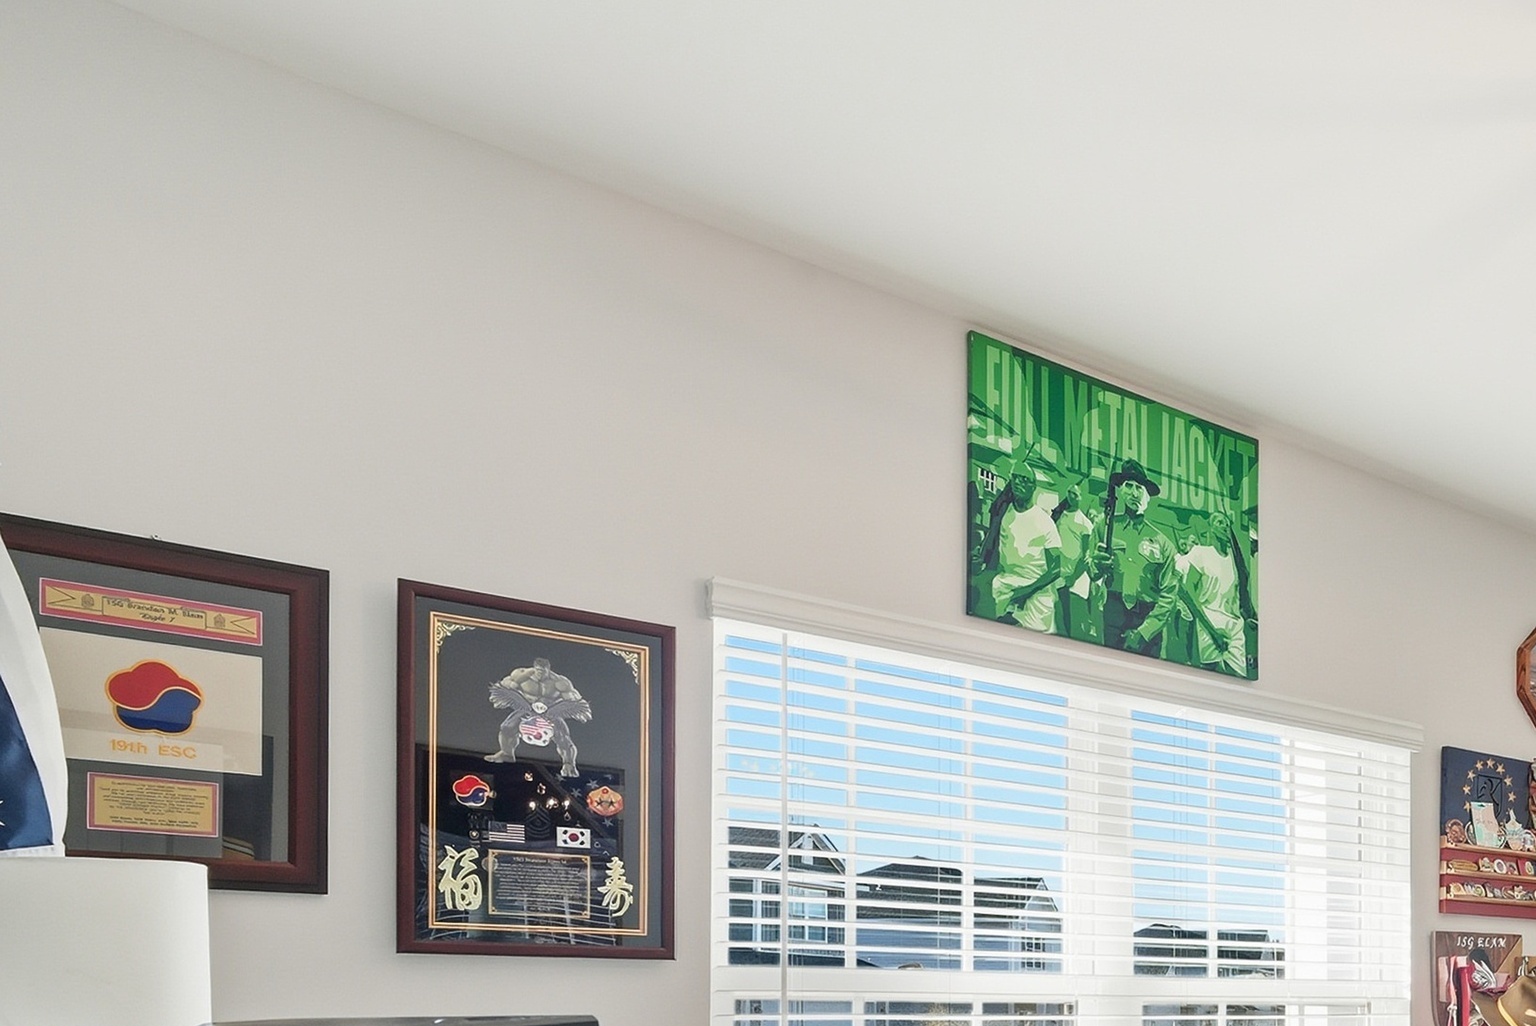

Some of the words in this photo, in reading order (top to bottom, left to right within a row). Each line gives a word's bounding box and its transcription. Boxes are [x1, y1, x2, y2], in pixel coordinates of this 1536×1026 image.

[986, 344, 1059, 463] FULL
[1064, 374, 1151, 482] METAL
[1160, 411, 1256, 530] JACKET
